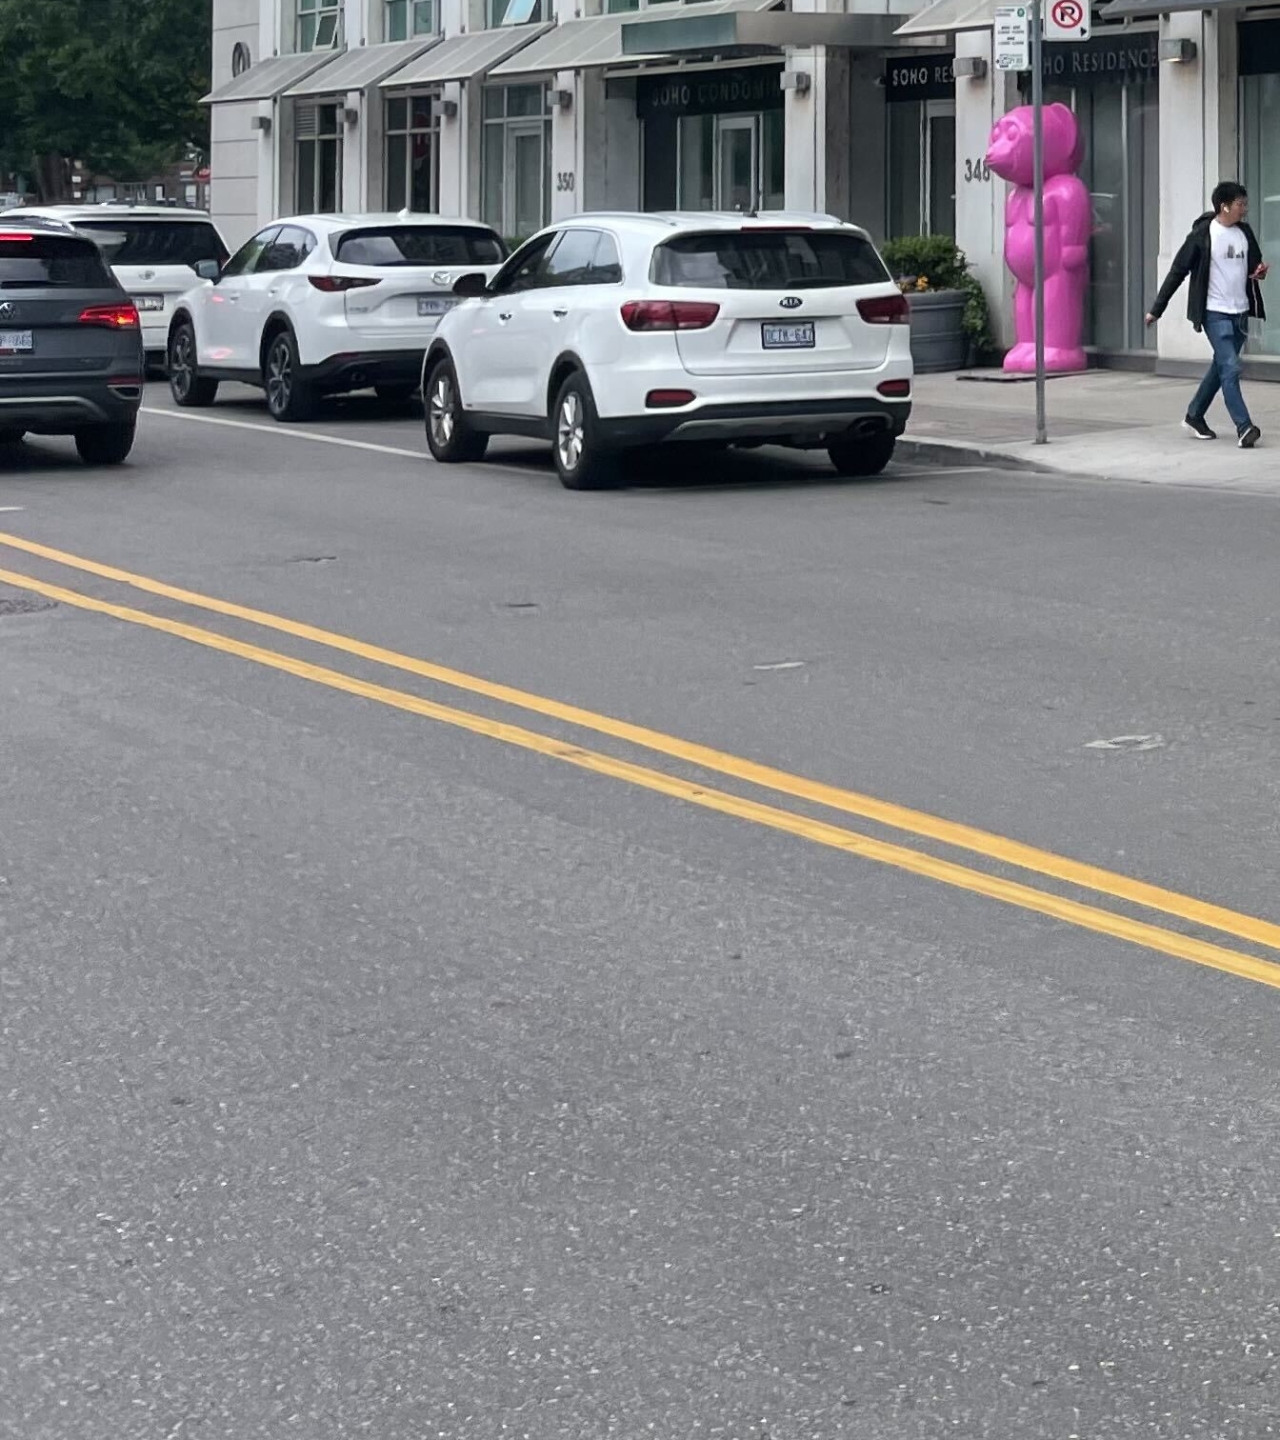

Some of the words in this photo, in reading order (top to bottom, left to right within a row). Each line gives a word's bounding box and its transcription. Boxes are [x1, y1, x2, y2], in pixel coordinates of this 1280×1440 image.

[892, 67, 928, 87] SOHO
[652, 85, 691, 108] SOHO
[557, 172, 575, 192] 350
